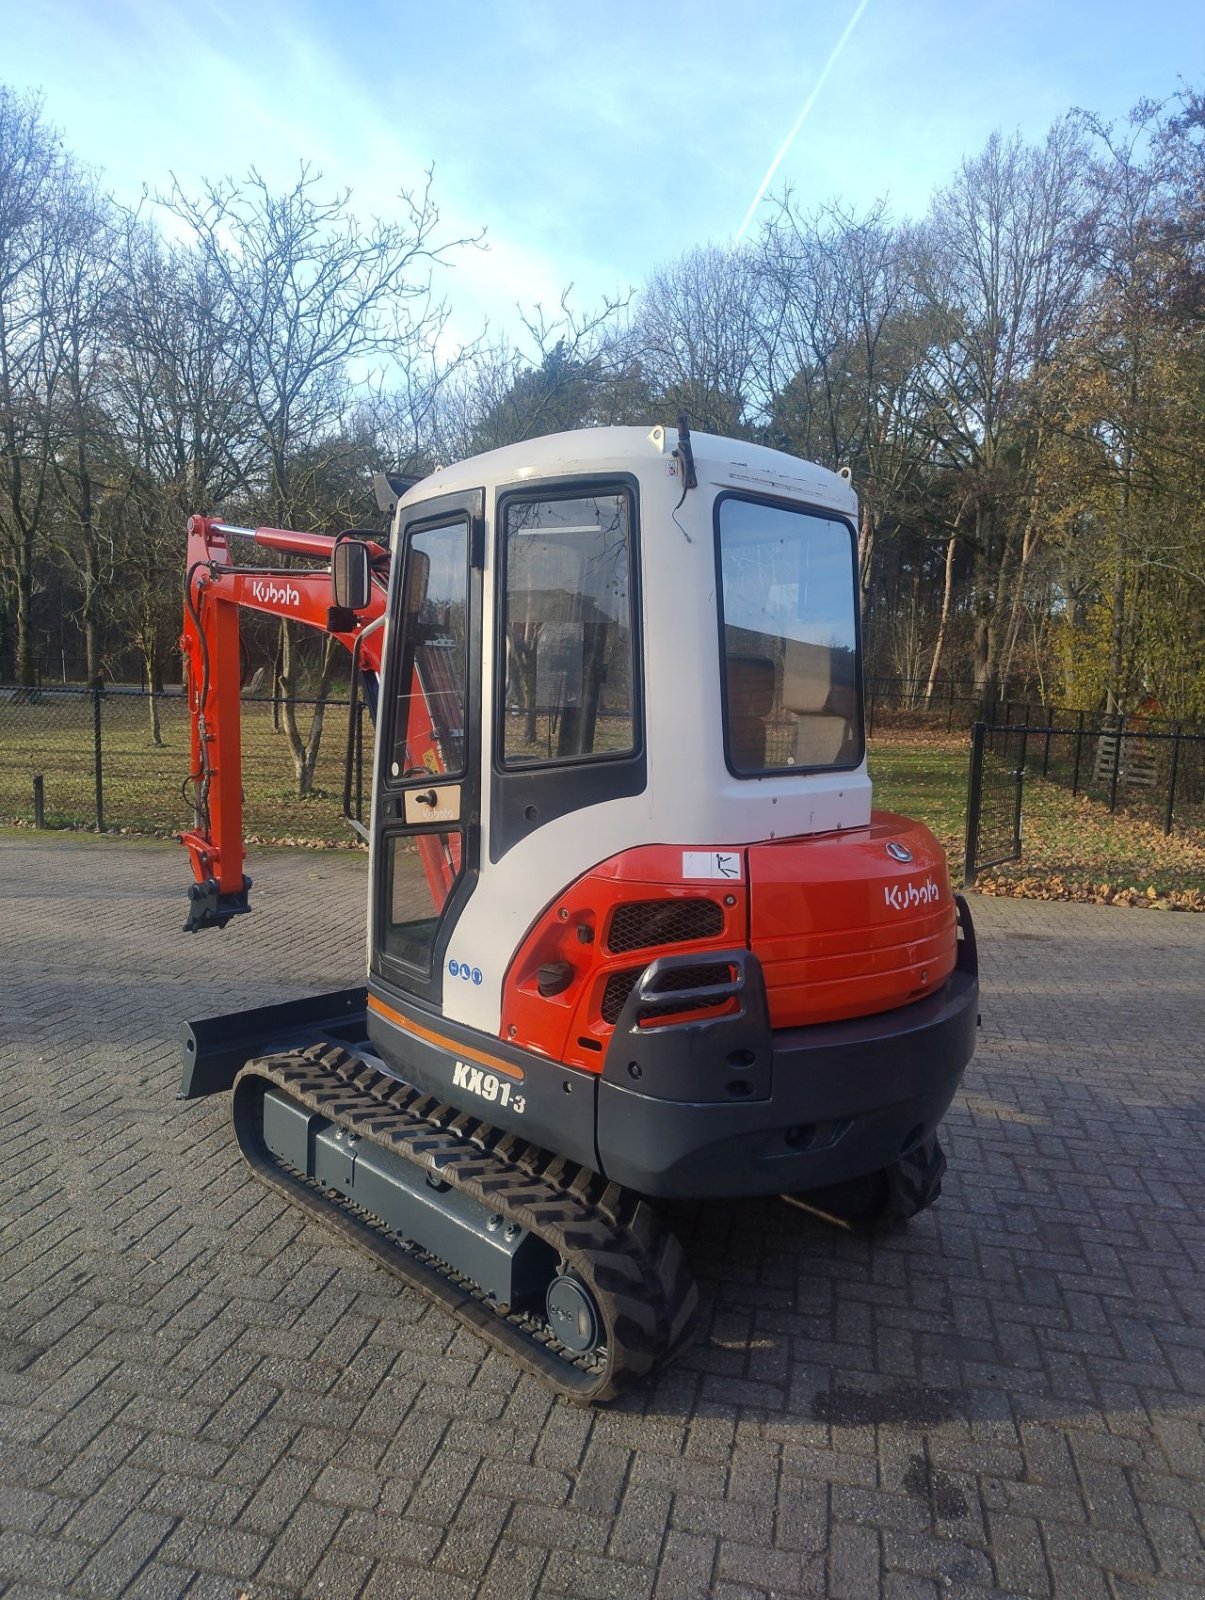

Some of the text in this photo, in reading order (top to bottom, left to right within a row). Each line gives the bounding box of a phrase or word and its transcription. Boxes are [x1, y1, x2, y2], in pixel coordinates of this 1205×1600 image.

[253, 581, 300, 606] Kubota
[422, 807, 454, 820] Kubota
[884, 879, 940, 910] Kubota
[453, 1061, 526, 1114] KX91-3
